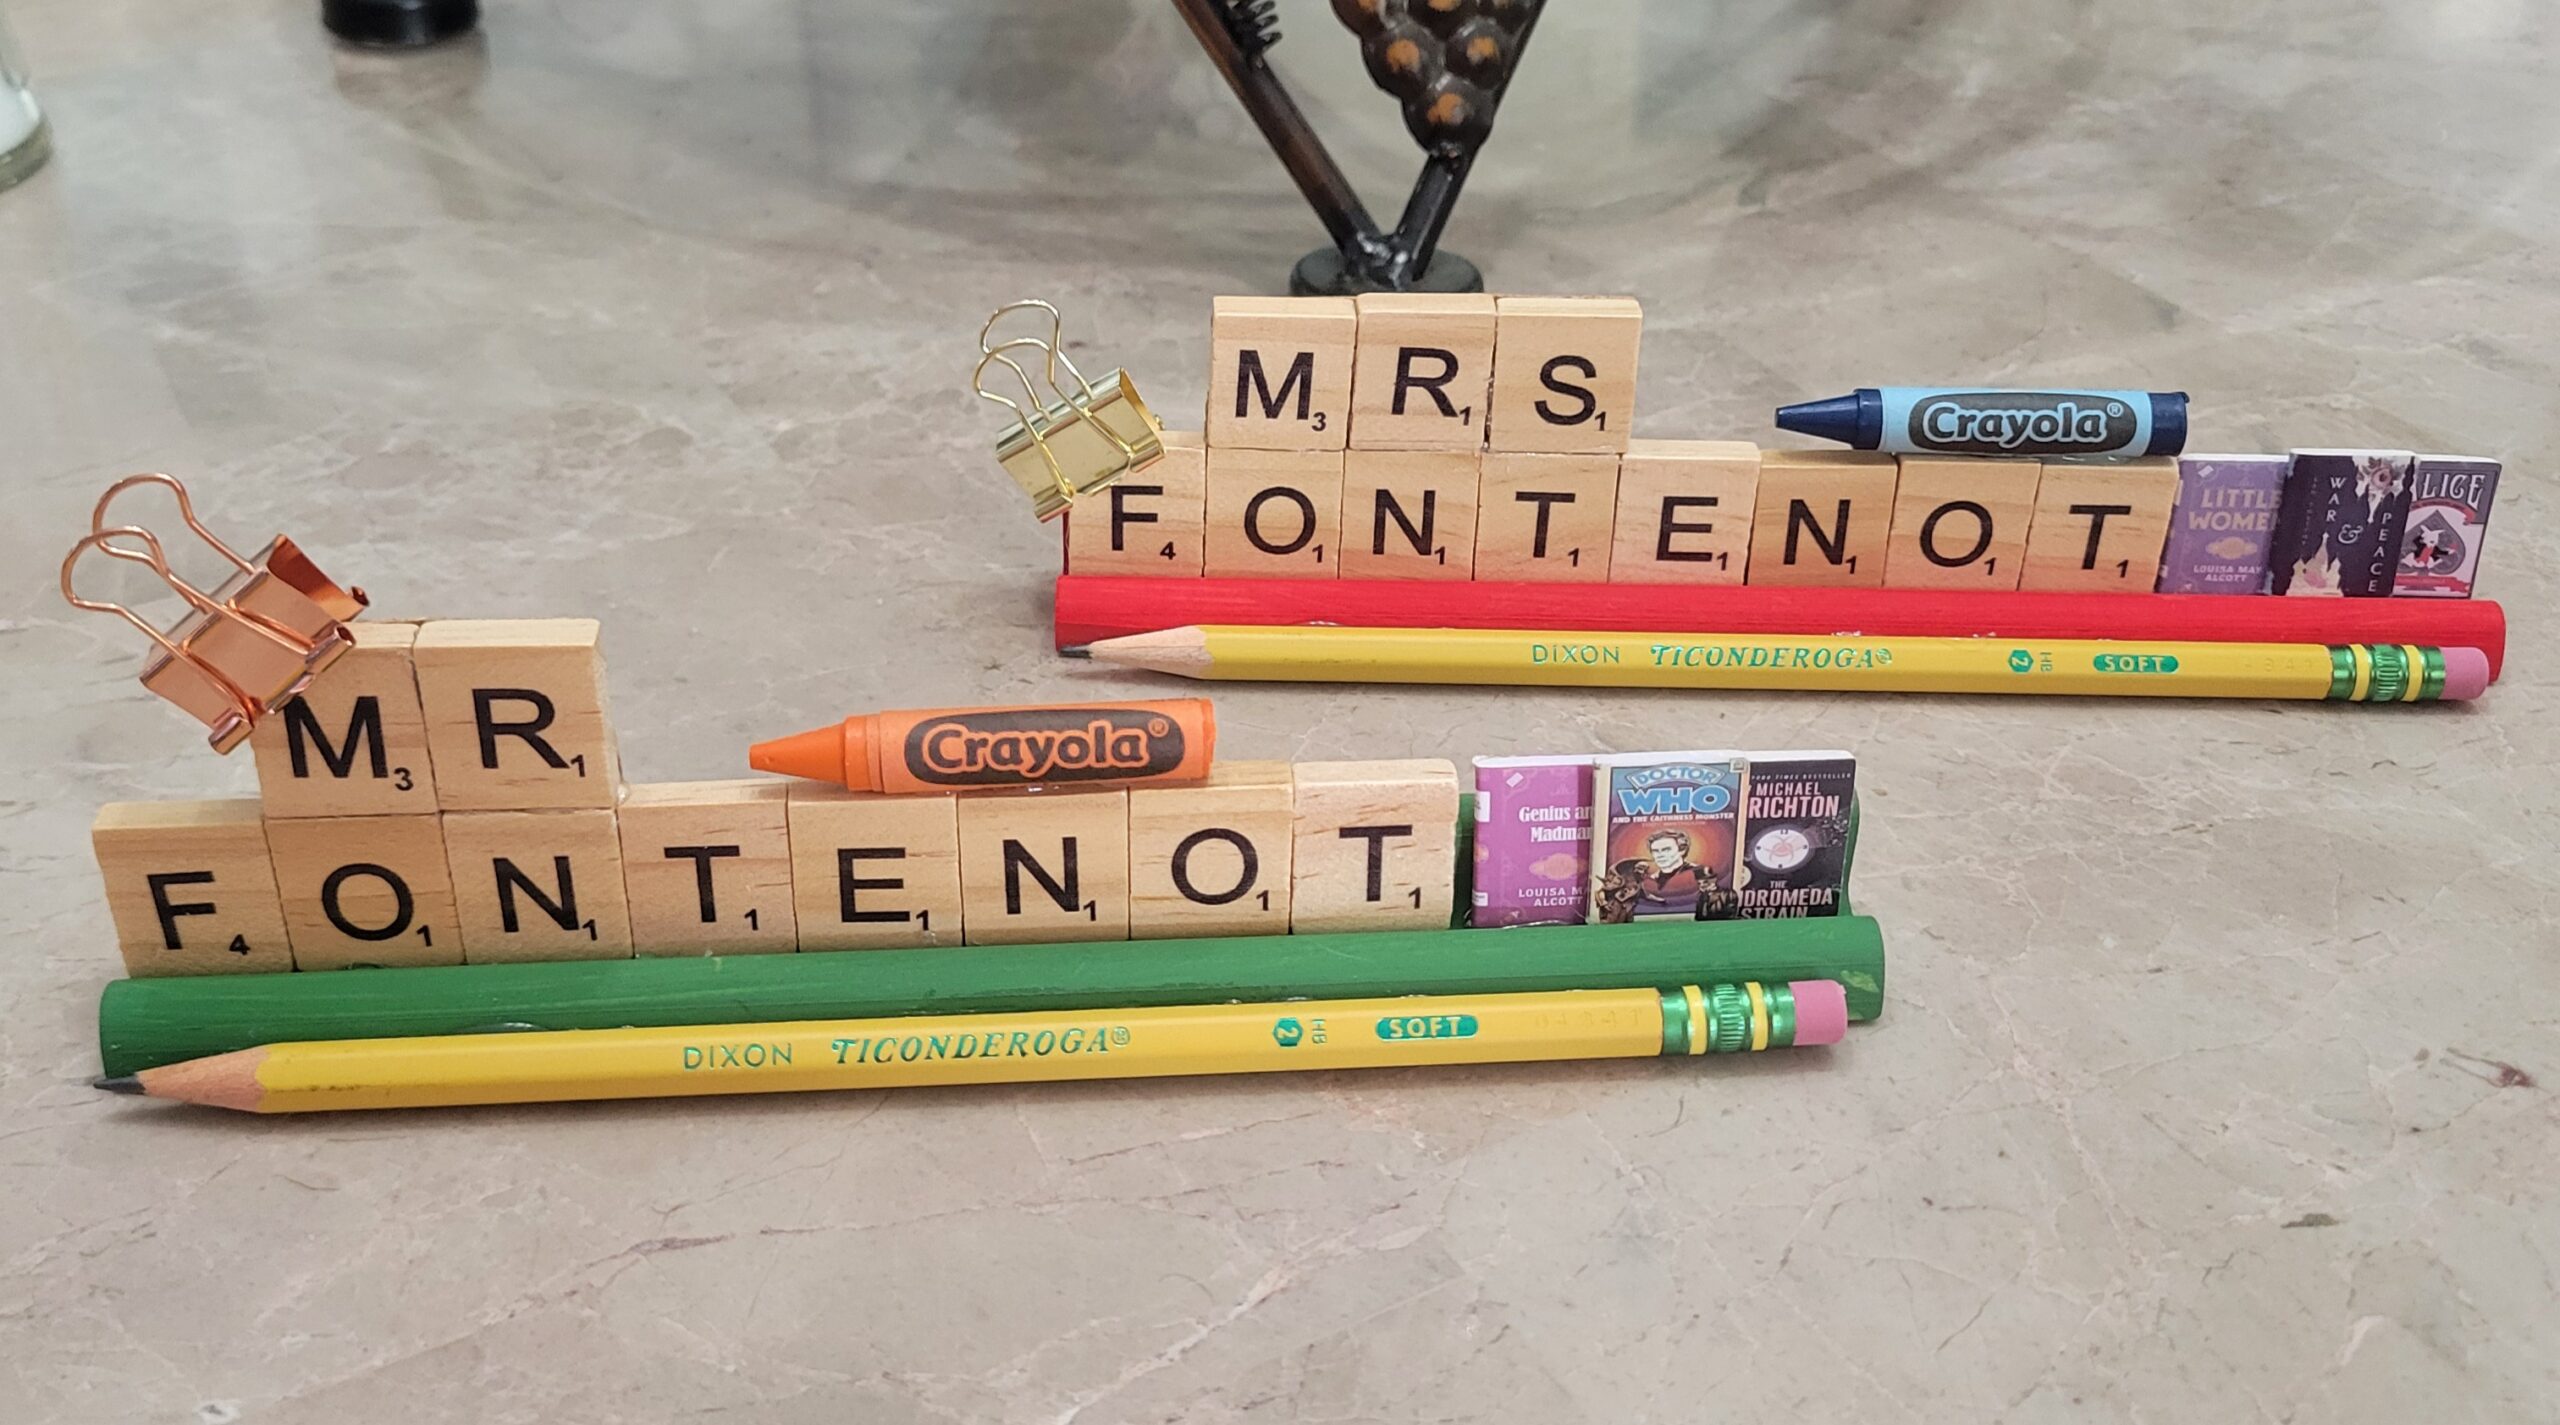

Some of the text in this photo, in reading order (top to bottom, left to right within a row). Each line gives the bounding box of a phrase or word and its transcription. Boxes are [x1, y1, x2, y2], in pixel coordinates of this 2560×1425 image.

[1235, 347, 1596, 426] MRS
[1311, 406, 1607, 431] 3 1 1
[2201, 489, 2281, 508] LITTLE
[2326, 477, 2346, 521] WAR
[1110, 486, 2131, 569] FONTENOT
[2338, 524, 2363, 544] &
[1160, 542, 2129, 578] 4 1 1 1 1 1 1 1
[2368, 512, 2392, 592] PEACE
[2193, 565, 2234, 573] LOUISA
[1532, 644, 1620, 664] DIXON
[2039, 652, 2053, 672] HB
[2103, 655, 2166, 674] SOFT
[283, 688, 570, 778] MR
[393, 755, 587, 791] 3 1
[1636, 766, 1717, 785] DOCTOR
[1618, 785, 1730, 815] WHO
[1756, 782, 1821, 796] MICHAEL
[1519, 806, 1570, 822] Genius
[1612, 816, 1630, 824] AND
[147, 825, 1412, 950] FONTENOT
[1518, 888, 1566, 898] LOUISA
[1770, 880, 1787, 889] THE
[1534, 896, 1583, 906] ALCOTT
[229, 886, 1422, 956] 4 1 1 1 1 1 1 1
[1311, 1018, 1329, 1044] HB
[1389, 1016, 1463, 1039] SOFT
[684, 1043, 792, 1069] DIXON
